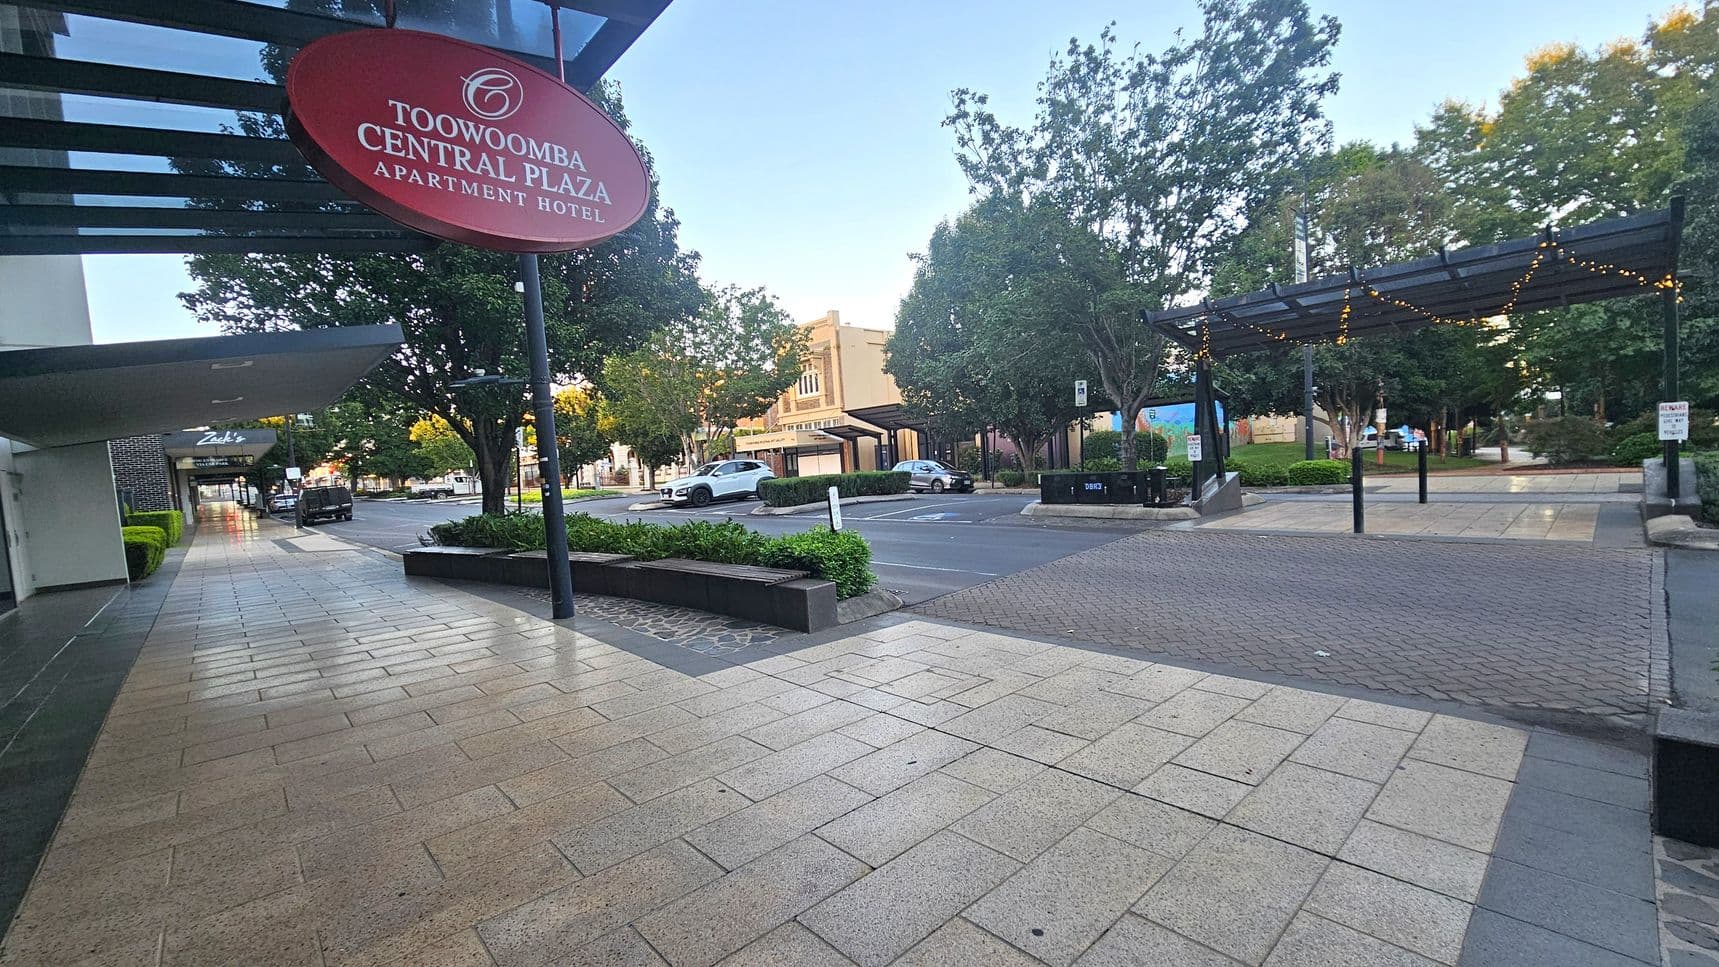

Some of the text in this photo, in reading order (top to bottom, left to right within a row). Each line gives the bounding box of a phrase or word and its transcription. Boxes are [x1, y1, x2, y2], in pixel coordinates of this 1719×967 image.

[357, 122, 613, 206] CENTRAL PLAZA
[388, 99, 588, 173] TOOWOOMBA
[373, 161, 606, 223] APARTMENT HOTEL
[196, 431, 246, 446] Zack's
